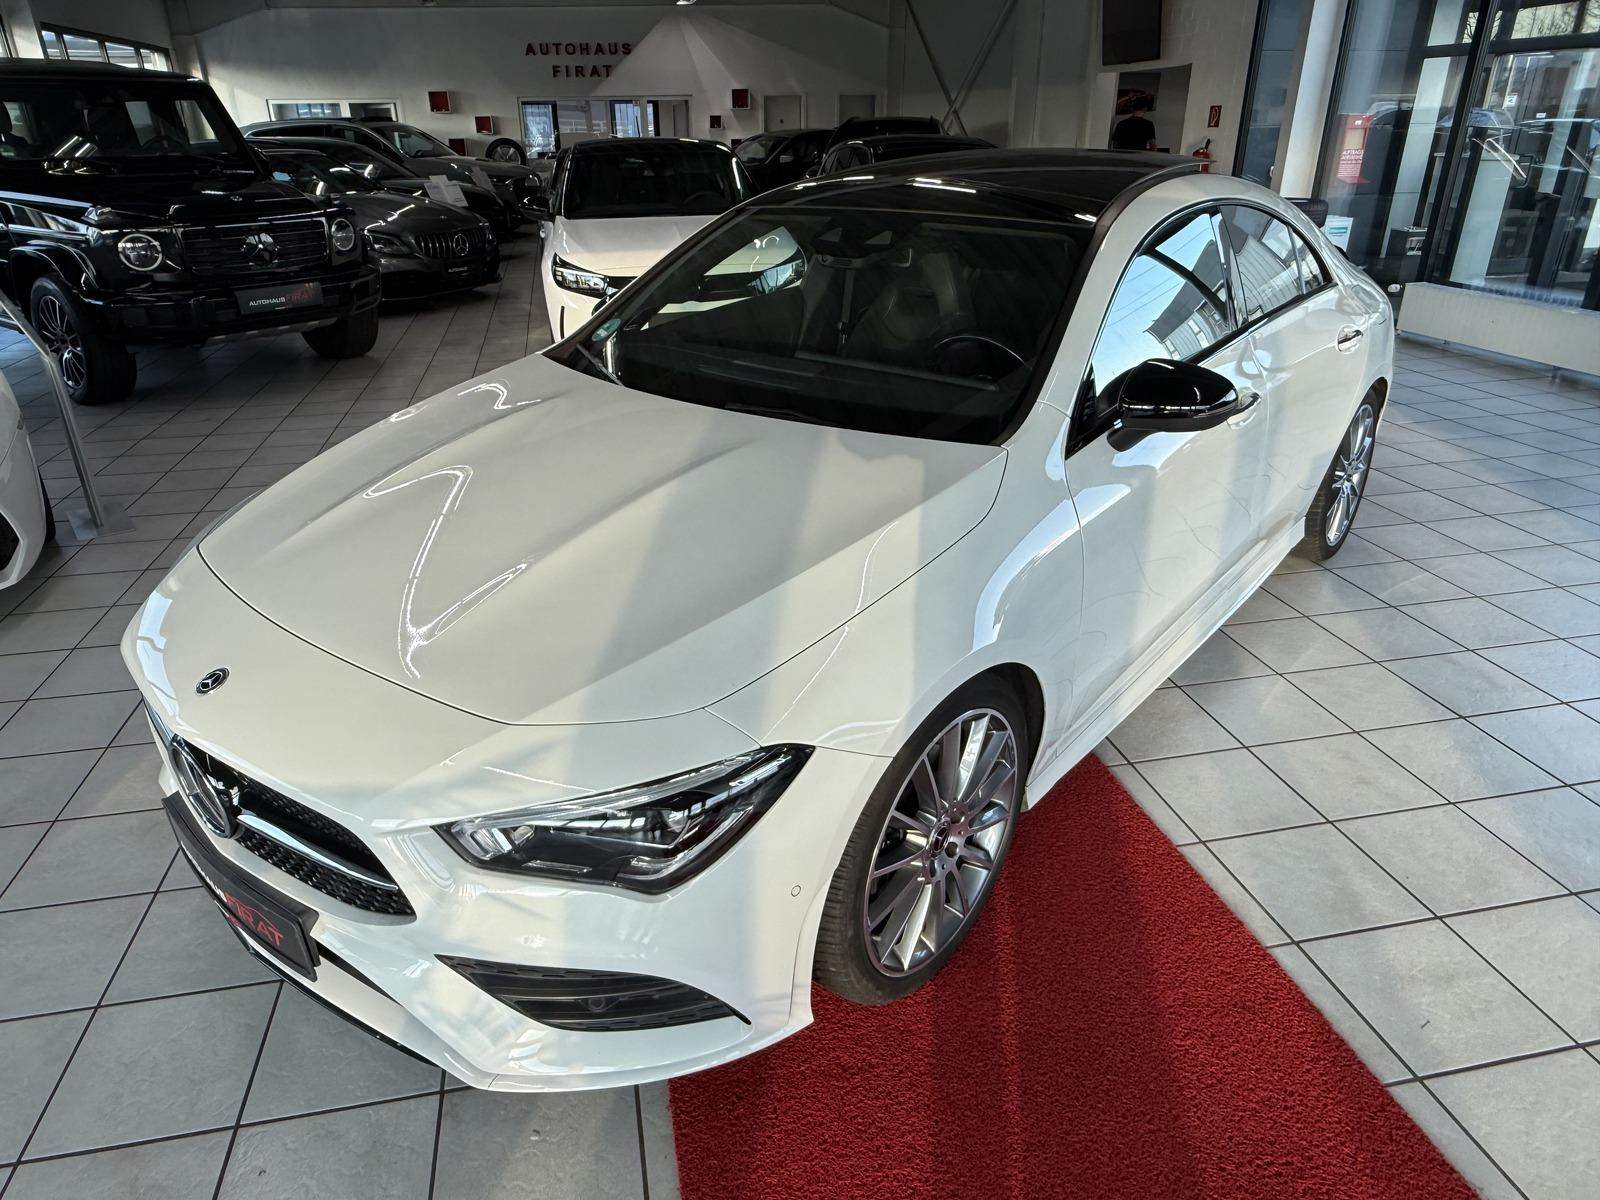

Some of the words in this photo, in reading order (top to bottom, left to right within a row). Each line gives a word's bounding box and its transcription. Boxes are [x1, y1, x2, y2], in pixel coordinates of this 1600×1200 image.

[525, 42, 633, 56] AUTOHAUS
[552, 64, 614, 78] FIRAT
[249, 296, 286, 306] AUTOHAUS
